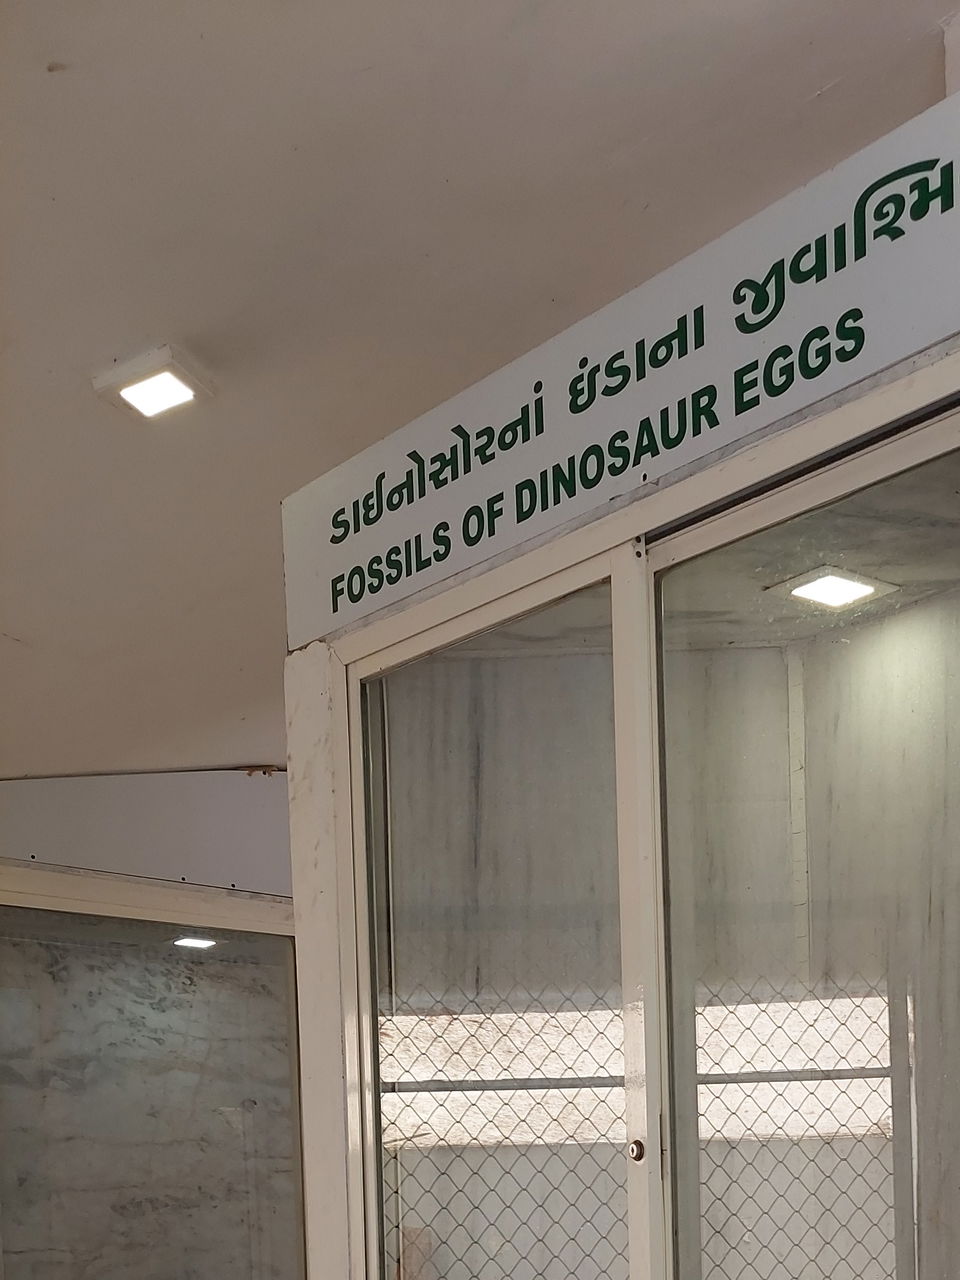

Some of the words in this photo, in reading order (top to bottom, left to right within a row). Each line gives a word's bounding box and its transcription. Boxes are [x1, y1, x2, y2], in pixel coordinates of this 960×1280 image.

[331, 521, 451, 614] FOSSILS
[462, 491, 504, 547] OF
[515, 384, 720, 524] DINOSAUR
[734, 308, 865, 416] EGGS
